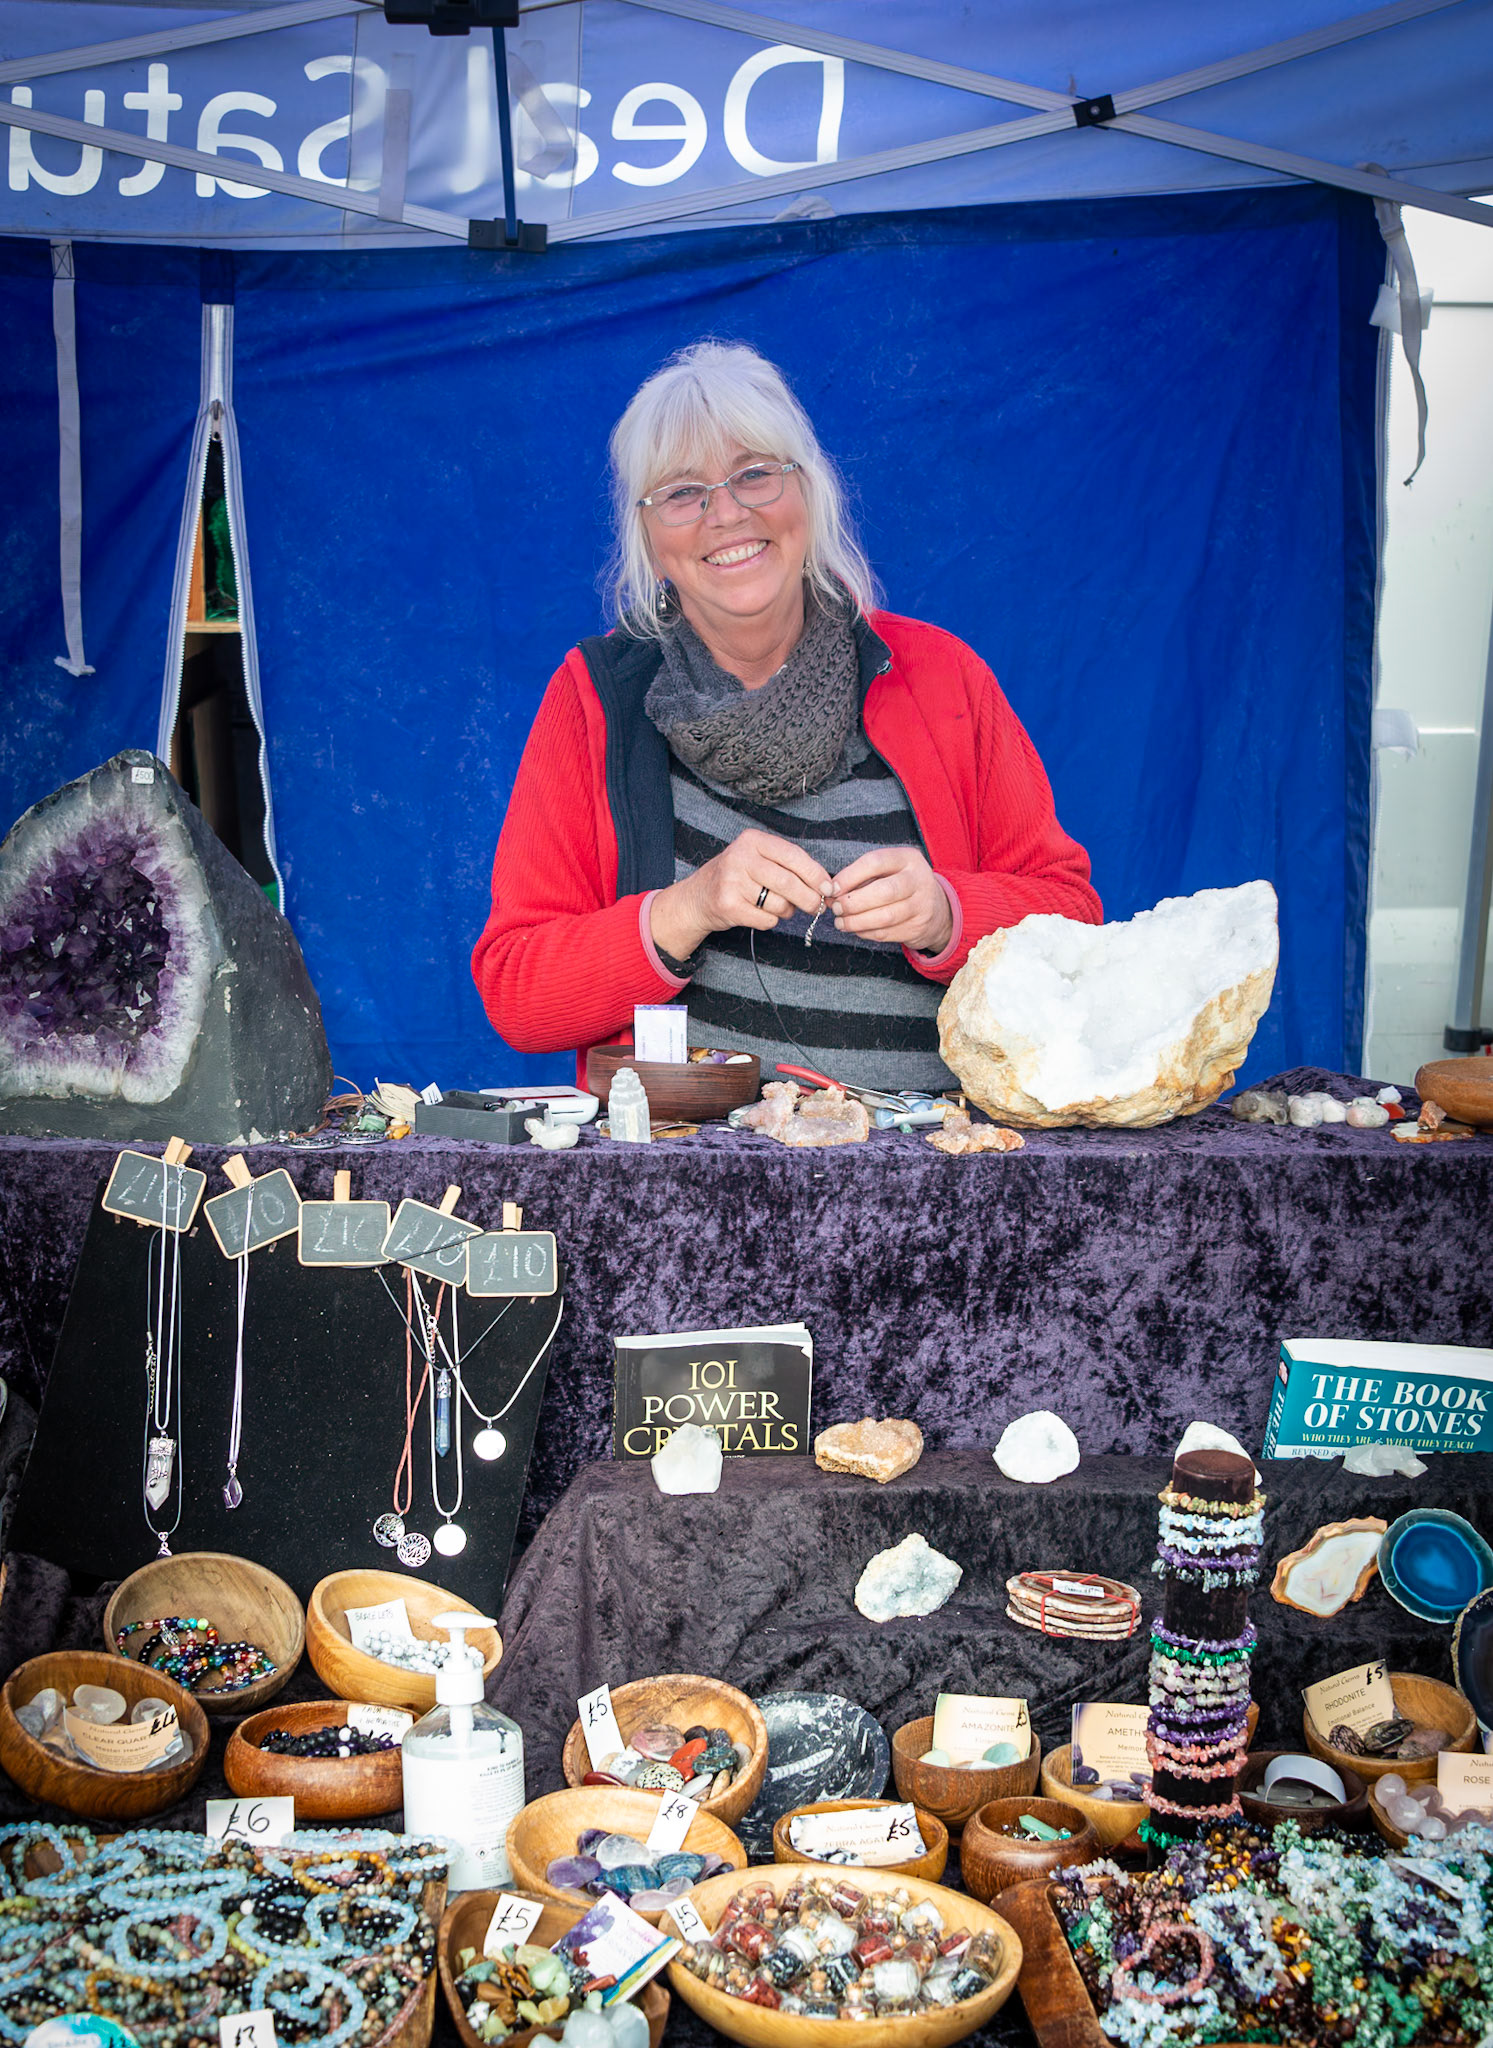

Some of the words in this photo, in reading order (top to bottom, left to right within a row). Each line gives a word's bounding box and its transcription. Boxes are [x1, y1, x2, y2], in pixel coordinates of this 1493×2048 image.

[117, 1165, 187, 1211] £10
[394, 1215, 467, 1267] £10
[483, 1242, 548, 1286] £10
[1312, 1374, 1383, 1403] THE
[1391, 1381, 1493, 1412] BOOK
[641, 1391, 784, 1424] POWER
[1304, 1403, 1349, 1429] OF
[1356, 1406, 1484, 1436] STONES
[623, 1423, 799, 1455] CRTALS
[1302, 1433, 1326, 1443] WHO
[1327, 1434, 1352, 1444] THEY
[1355, 1435, 1374, 1445] ARE
[1385, 1437, 1414, 1447] WHAT
[1416, 1439, 1442, 1449] THEY
[1443, 1440, 1475, 1451] TEACH
[1291, 1448, 1329, 1457] REVISED
[1366, 1664, 1385, 1686] £5
[1320, 1680, 1341, 1695] Natural
[588, 1694, 608, 1728] £5
[1324, 1688, 1367, 1712] RHODONITE
[1105, 1710, 1137, 1719] Natural
[1327, 1711, 1352, 1727] Emotional
[1352, 1703, 1375, 1717] Balance
[83, 1731, 114, 1745] CLEAR
[961, 1722, 1016, 1733] AMAZONITE
[1107, 1728, 1144, 1737] AMETH
[1463, 1775, 1491, 1785] ROSE
[222, 1802, 271, 1838] £6
[662, 1799, 689, 1820] £8
[886, 1817, 916, 1842] £5
[496, 1903, 532, 1933] £5
[674, 1902, 699, 1933] £5
